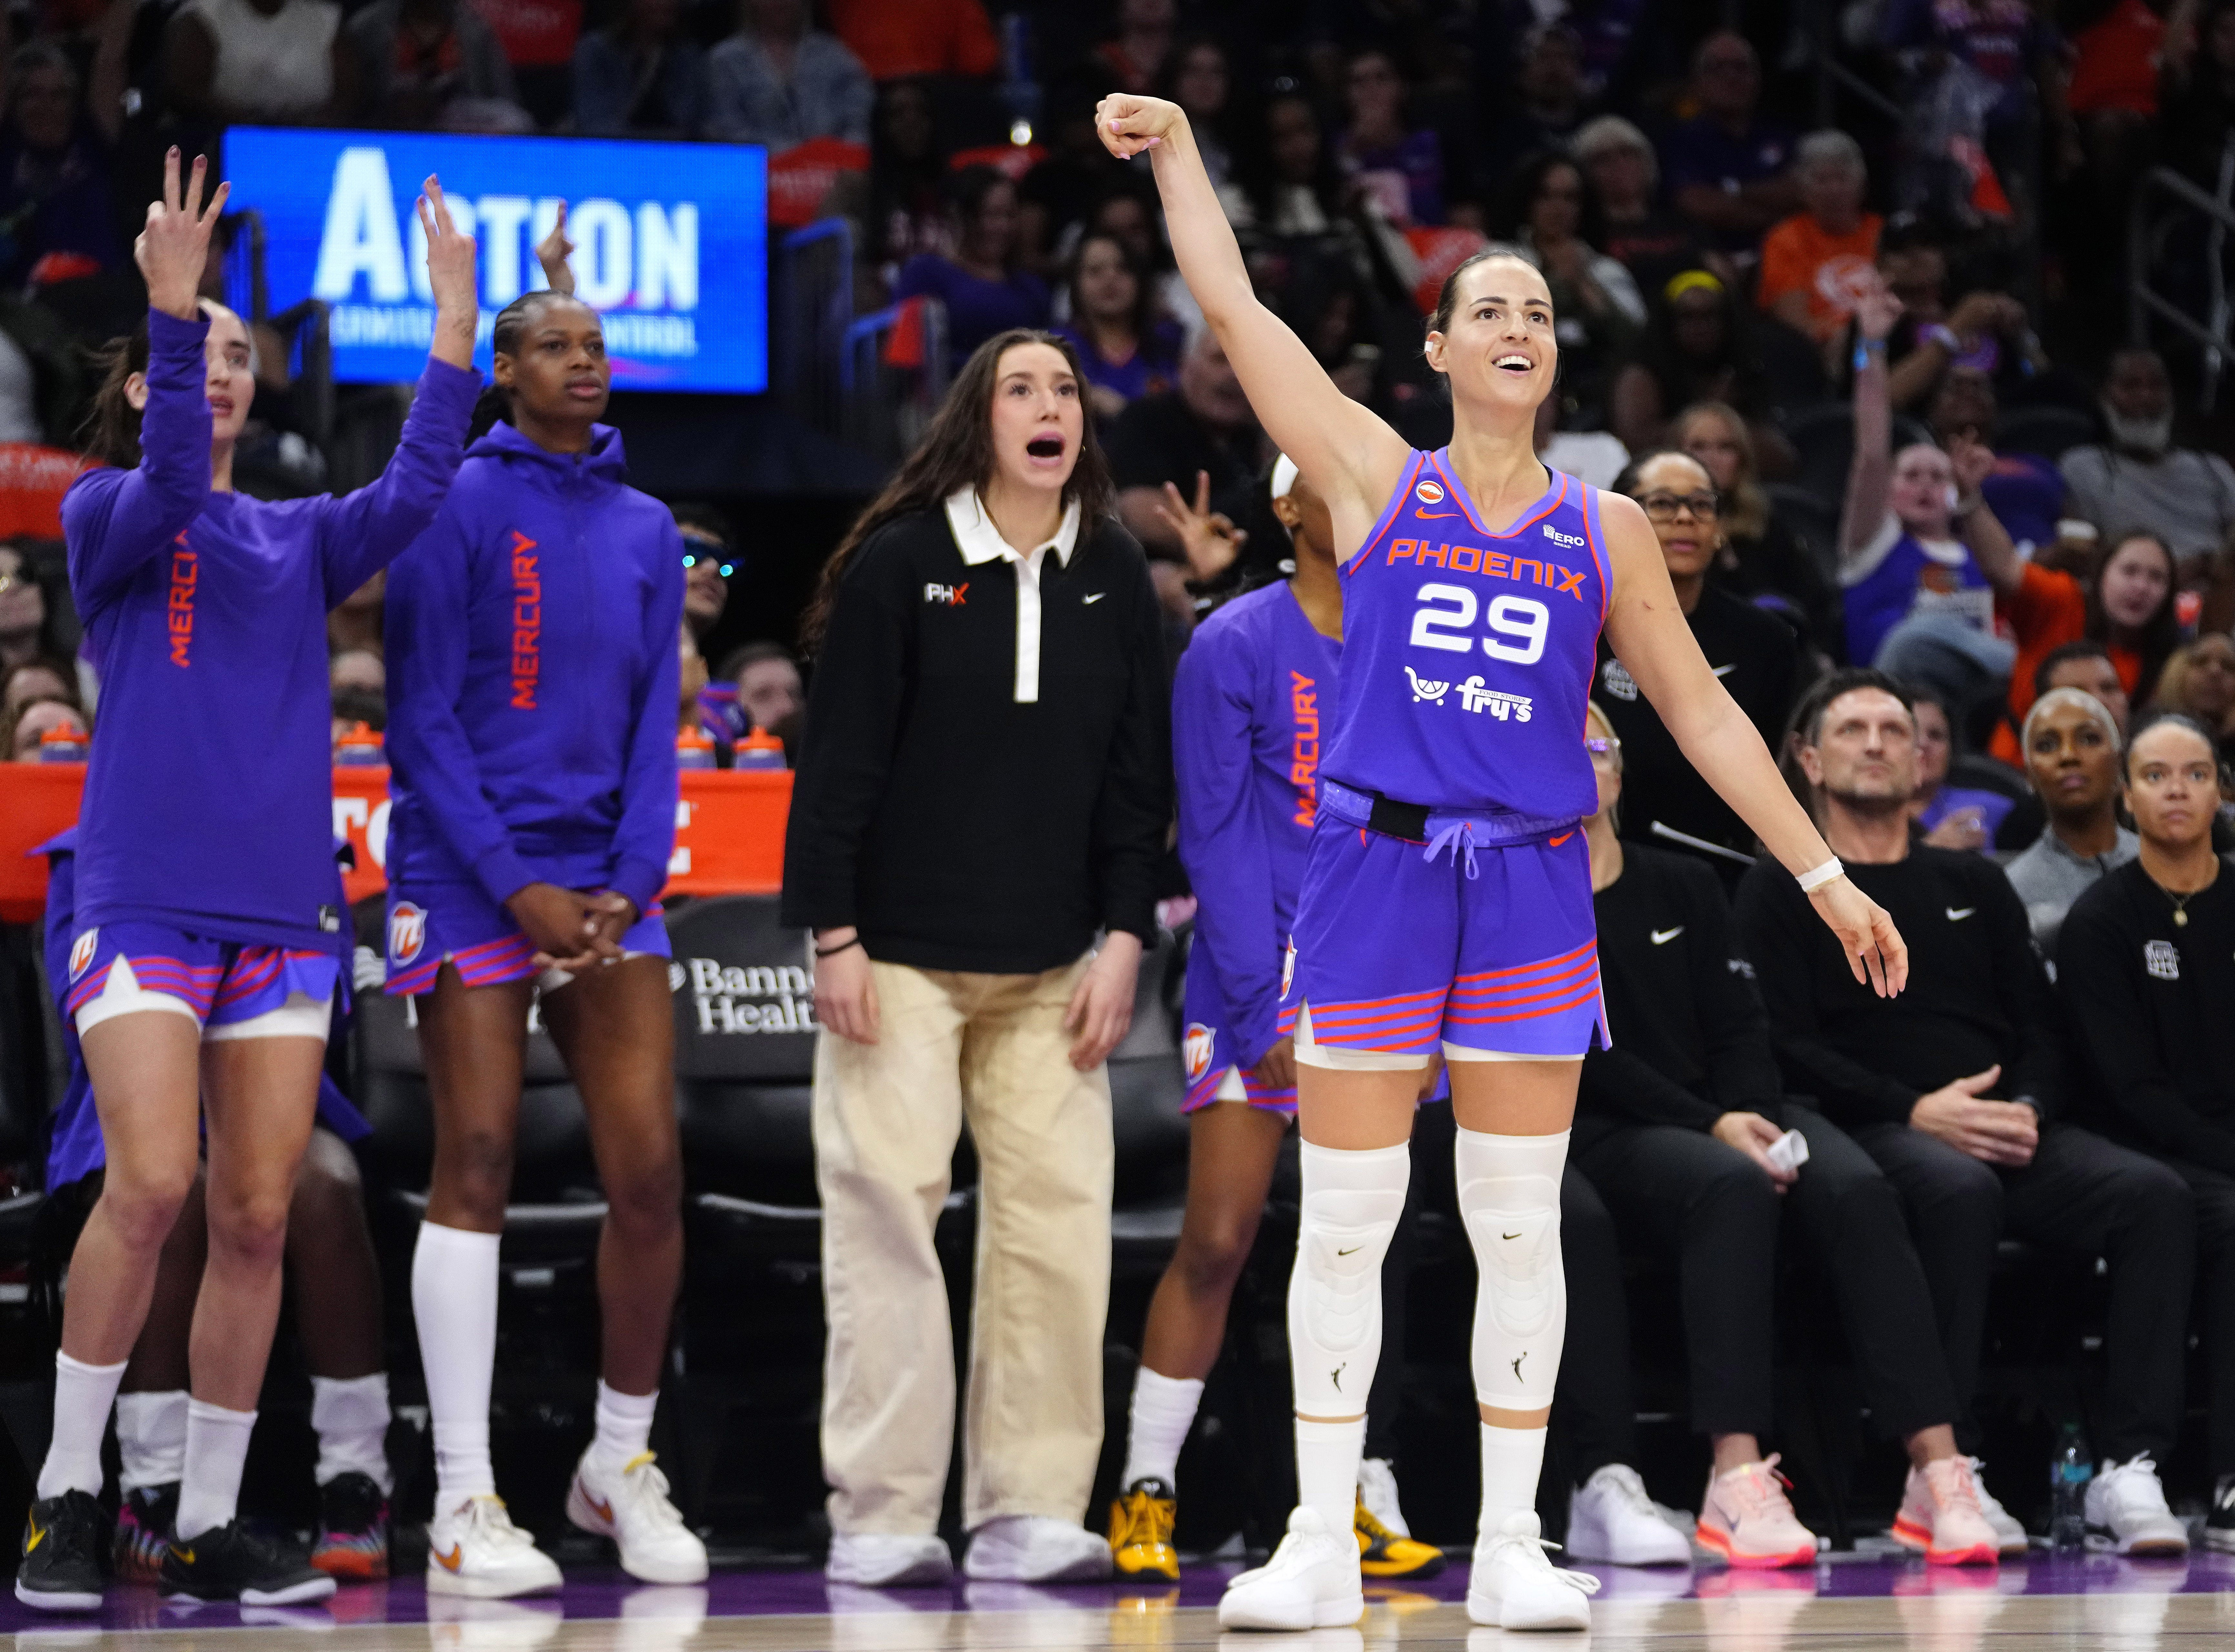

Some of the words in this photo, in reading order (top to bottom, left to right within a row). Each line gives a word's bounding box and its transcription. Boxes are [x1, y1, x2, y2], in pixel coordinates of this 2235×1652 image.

[1543, 524, 1584, 546] HERO
[1387, 538, 1587, 602] PHOENIX
[168, 529, 198, 668] MERC
[924, 582, 970, 606] PHX
[510, 531, 541, 710] MERCURY
[1410, 582, 1549, 666] 29
[1454, 675, 1533, 723] fry's
[1501, 694, 1526, 703] STORES
[691, 957, 814, 996] Bann
[697, 992, 819, 1035] Healt
